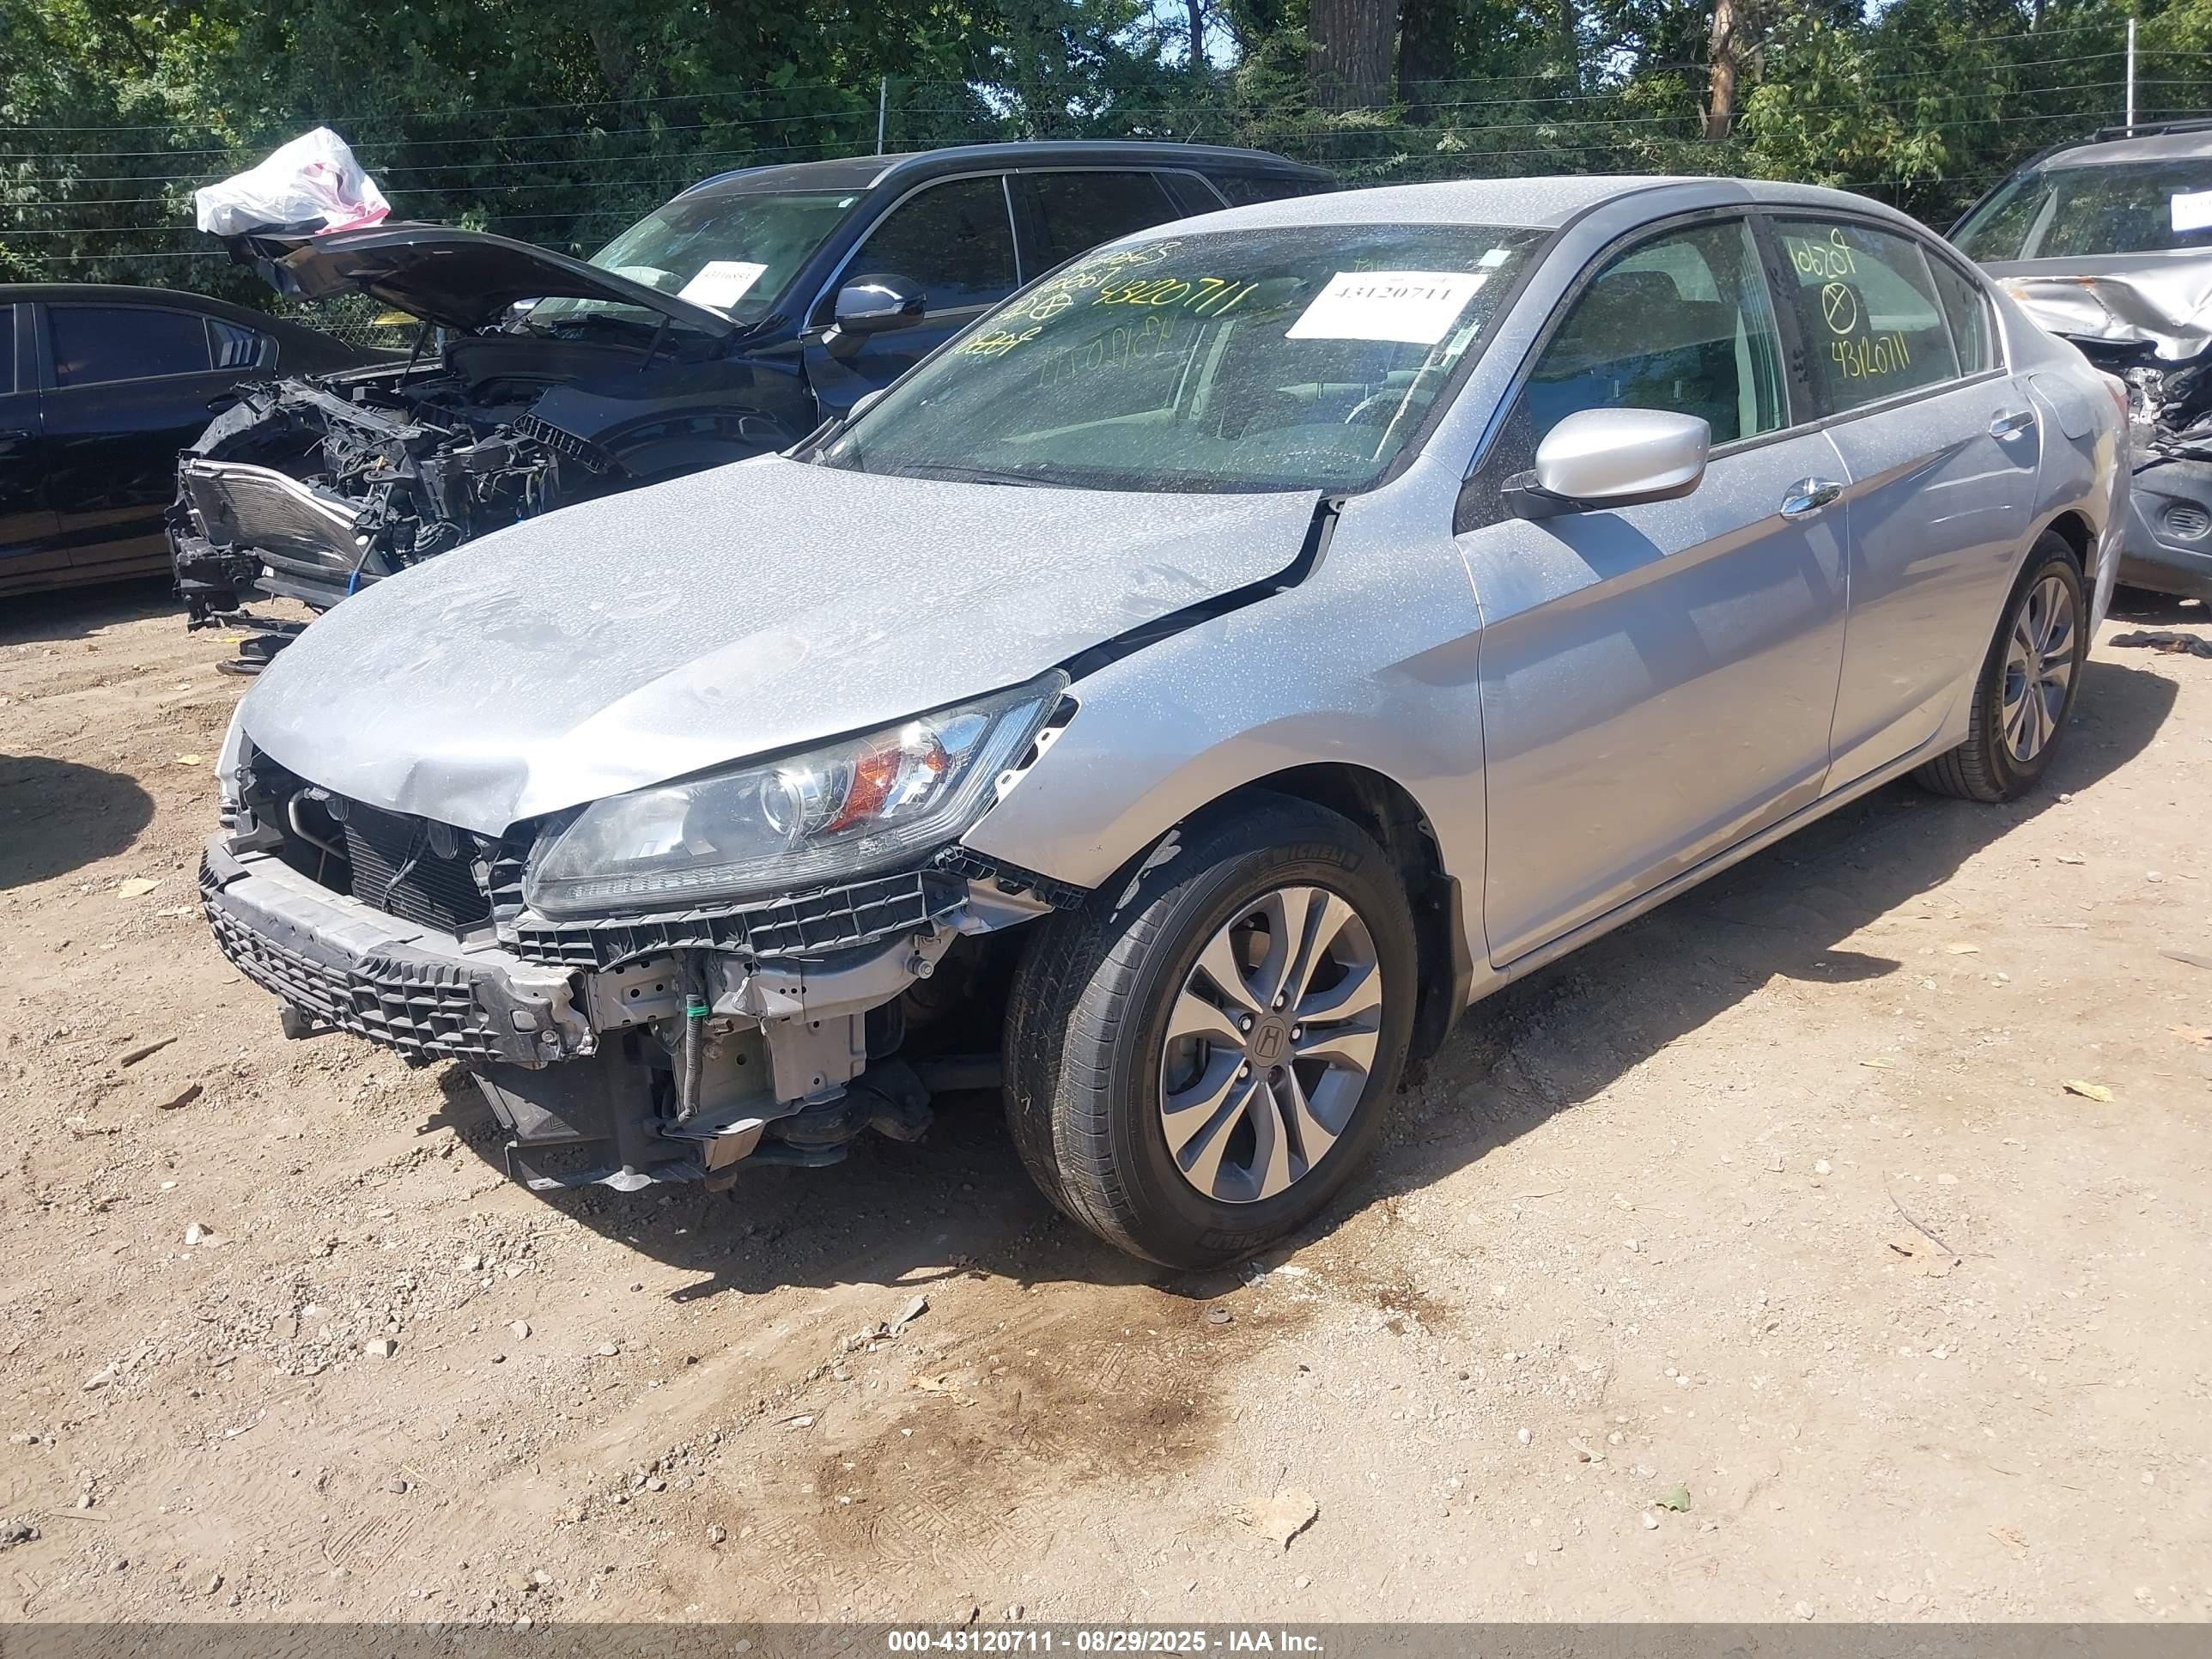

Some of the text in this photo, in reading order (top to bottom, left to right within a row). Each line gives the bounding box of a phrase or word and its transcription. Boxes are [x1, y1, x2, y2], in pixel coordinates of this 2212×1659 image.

[1091, 276, 1260, 318] 43120711
[1334, 286, 1455, 301] 43120711
[1832, 330, 1911, 380] 43120711
